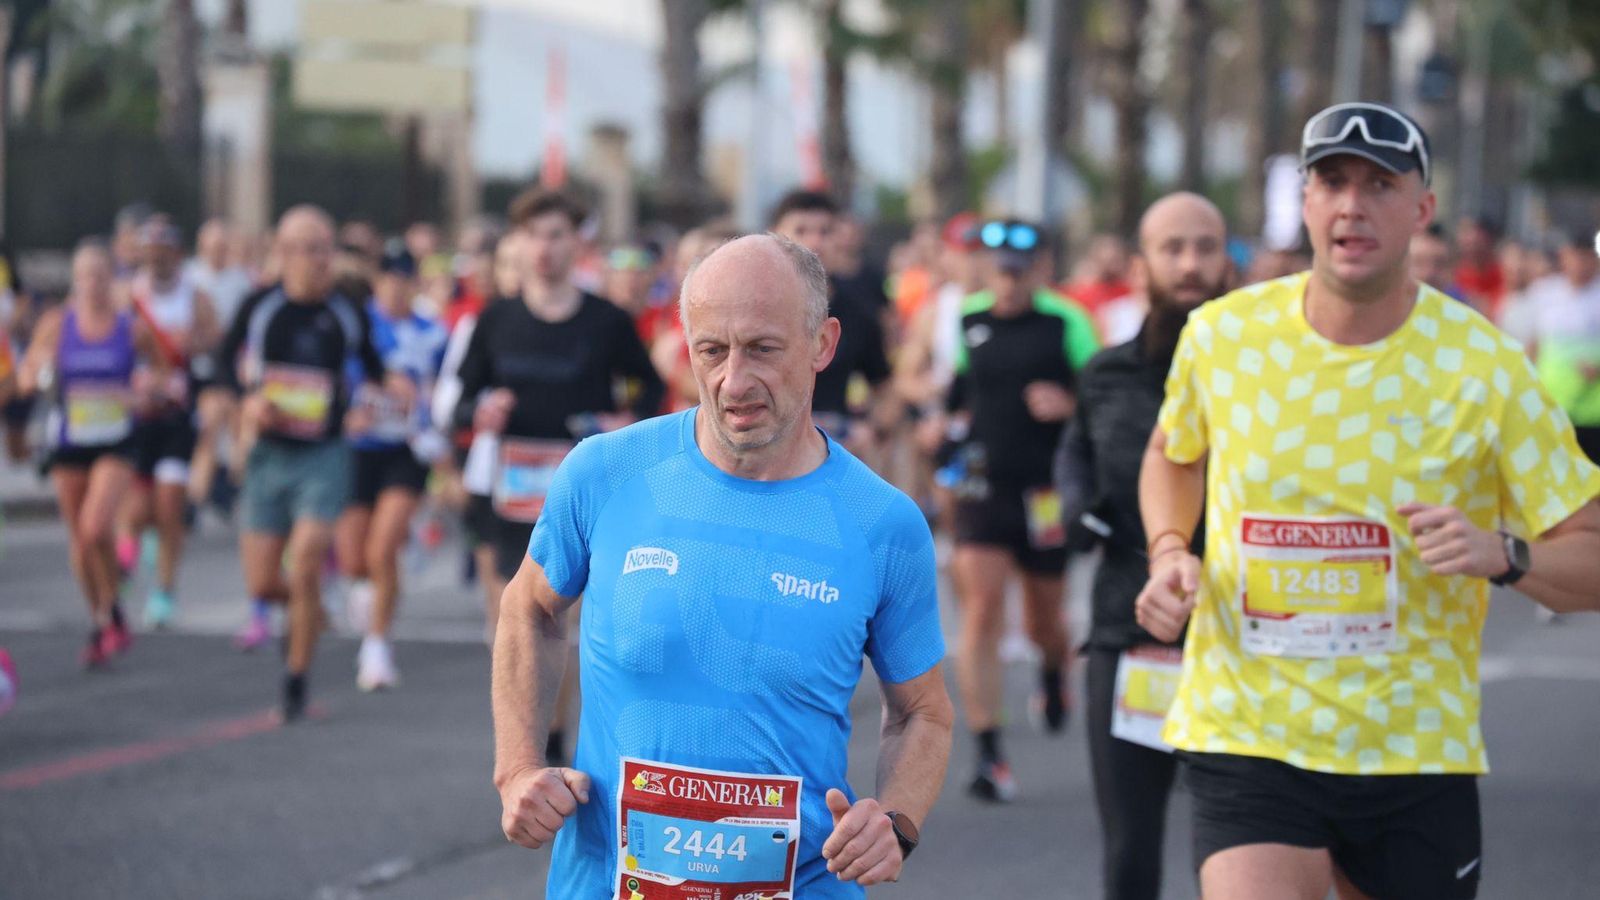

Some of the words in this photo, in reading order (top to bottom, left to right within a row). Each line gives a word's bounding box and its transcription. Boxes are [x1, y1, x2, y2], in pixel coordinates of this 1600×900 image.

[1276, 524, 1380, 546] GENERALI
[626, 550, 674, 569] Novelle
[770, 571, 839, 604] sparta
[1267, 567, 1361, 595] 12483
[663, 825, 748, 862] 2444
[687, 861, 720, 874] URVA
